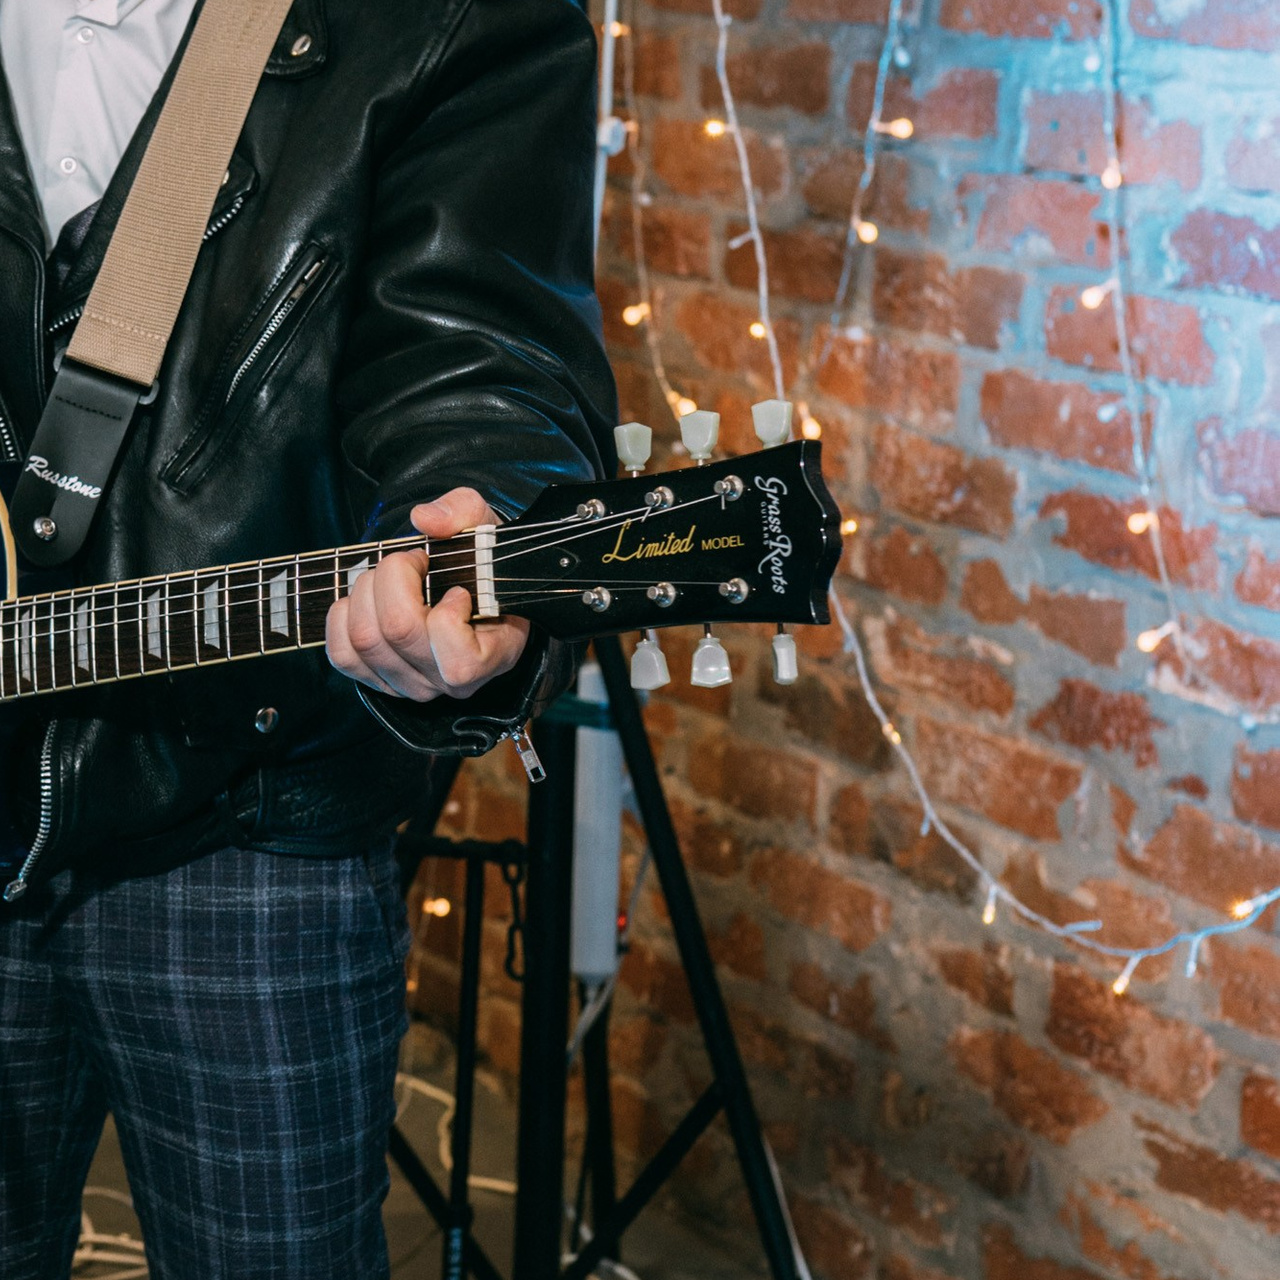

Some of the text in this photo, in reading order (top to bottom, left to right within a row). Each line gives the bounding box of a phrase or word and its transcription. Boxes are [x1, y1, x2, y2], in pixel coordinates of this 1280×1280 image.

[24, 455, 102, 499] Russtone
[602, 518, 745, 563] Limited MODEL
[760, 501, 770, 546] GUITARS
